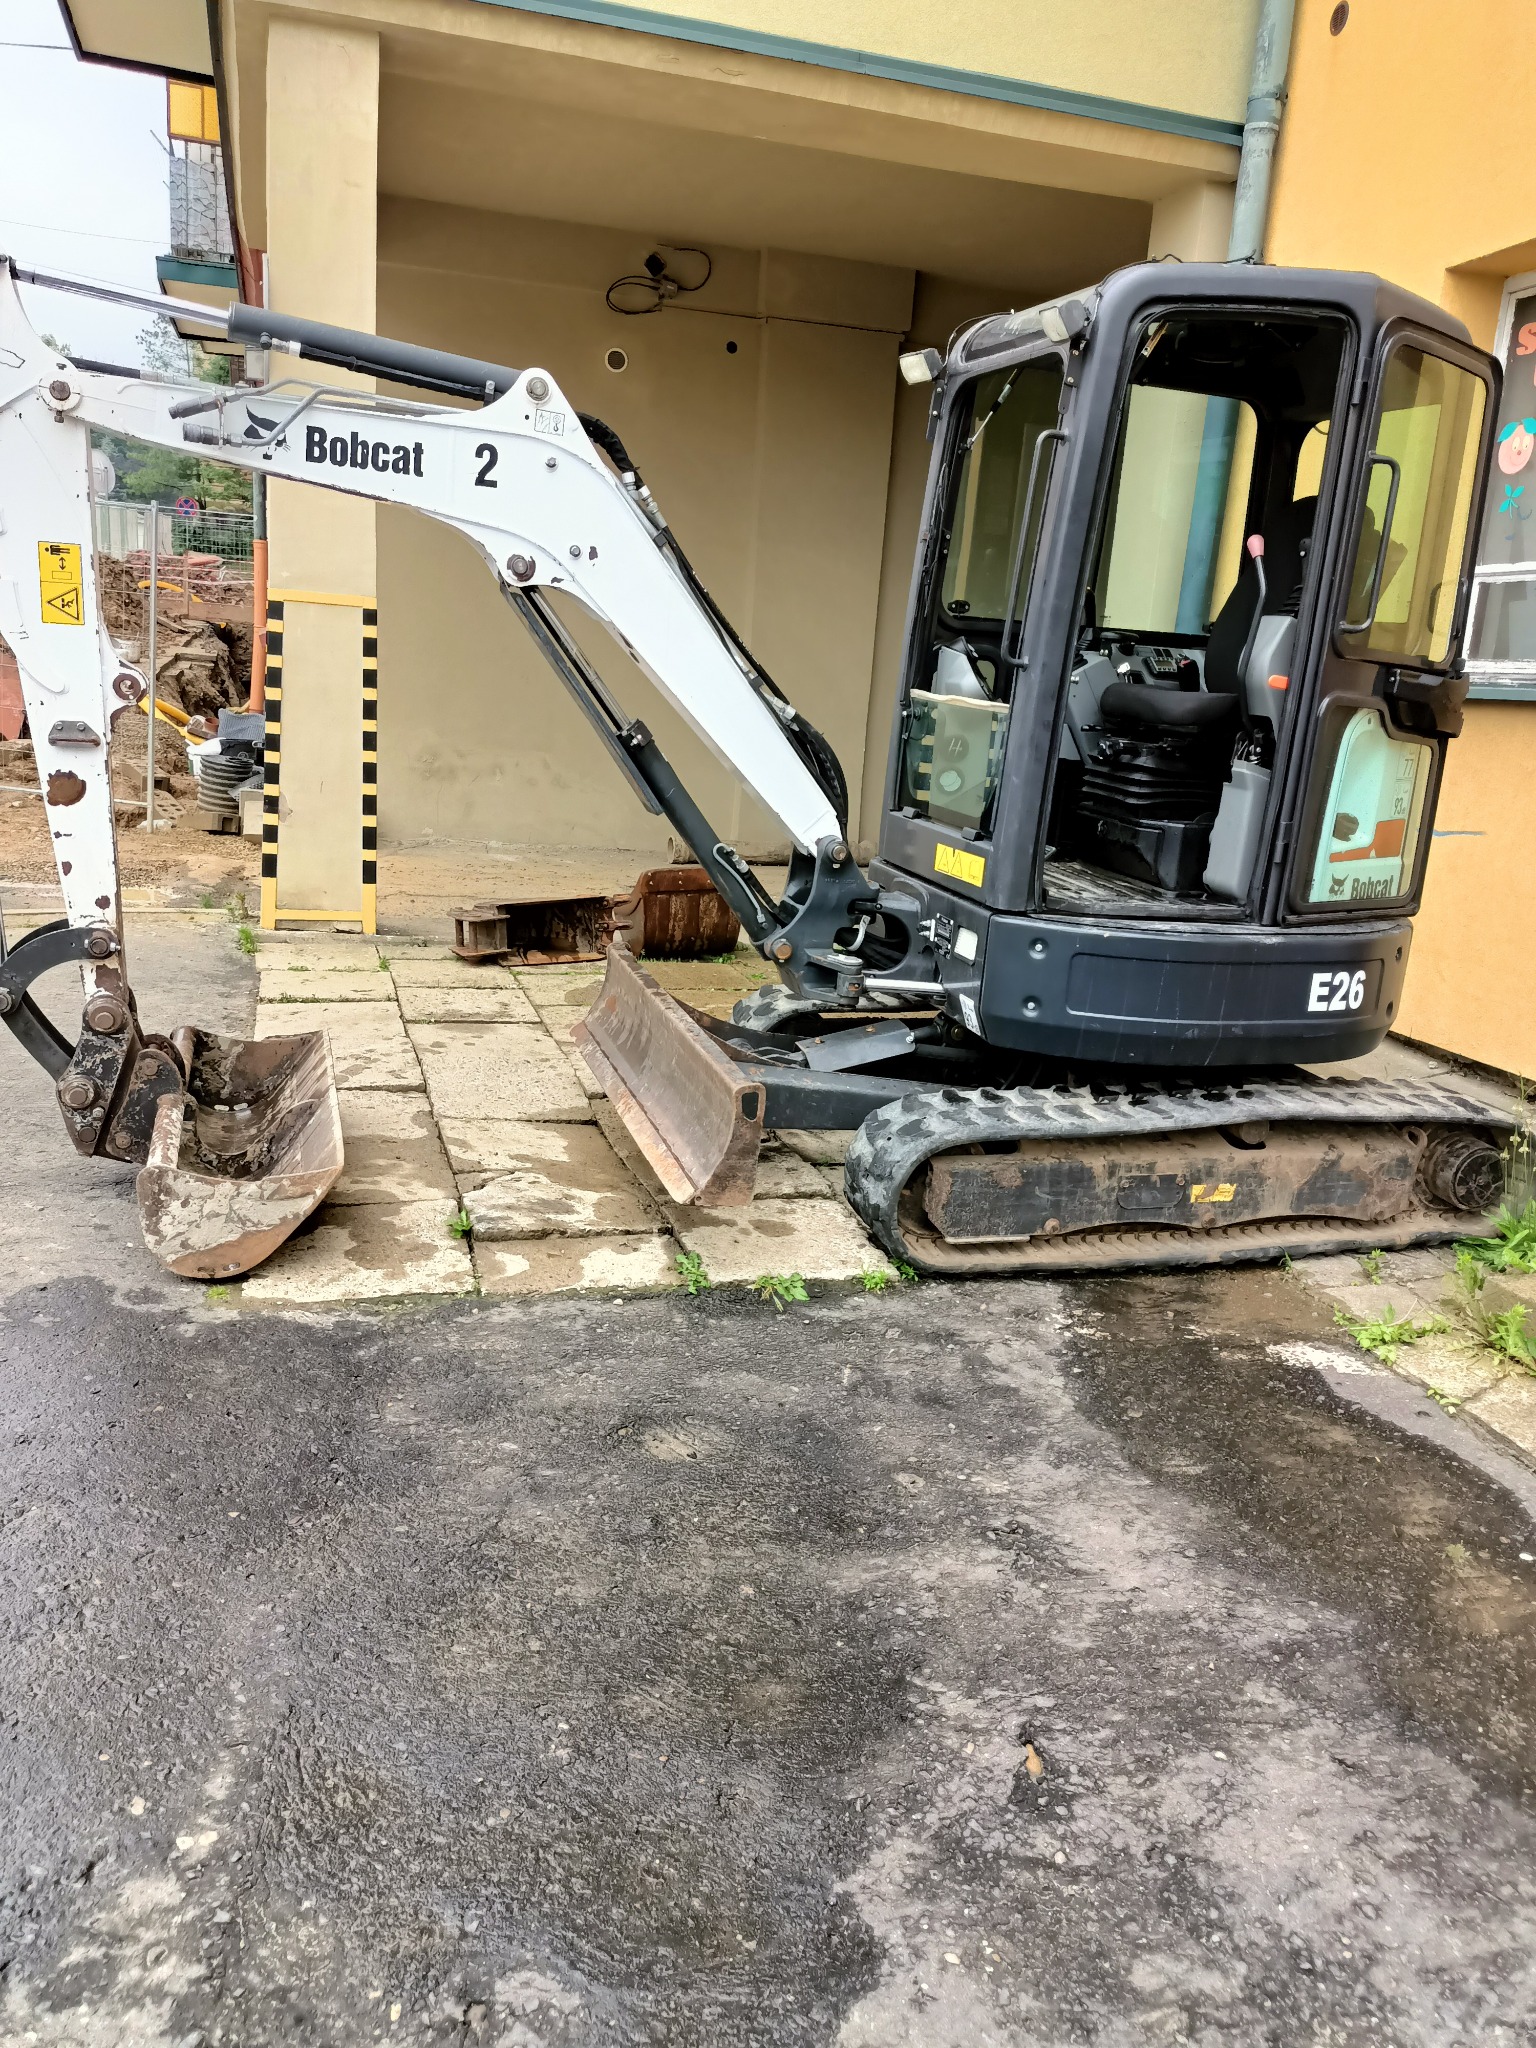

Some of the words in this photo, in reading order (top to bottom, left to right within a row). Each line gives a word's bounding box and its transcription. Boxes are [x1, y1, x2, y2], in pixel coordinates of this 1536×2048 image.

[305, 425, 424, 477] Bobcat
[475, 443, 499, 488] 2
[1307, 970, 1367, 1012] E26
